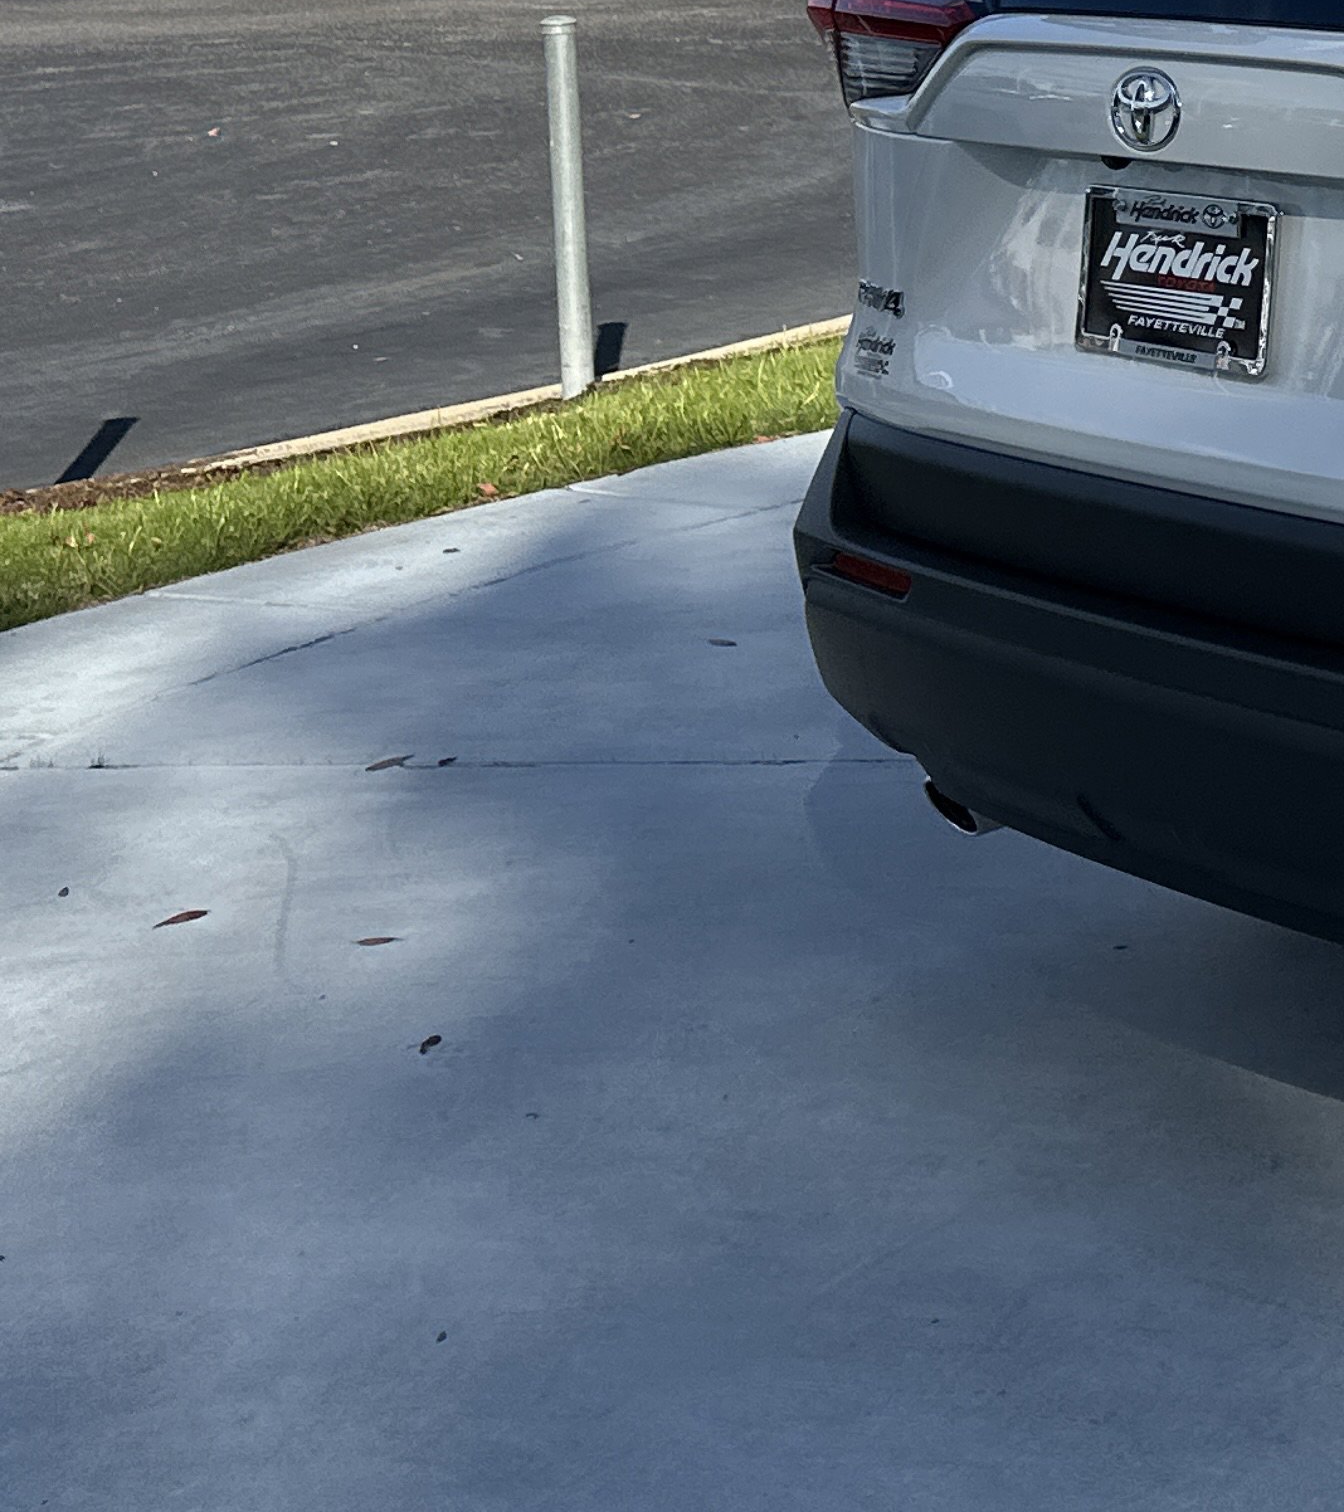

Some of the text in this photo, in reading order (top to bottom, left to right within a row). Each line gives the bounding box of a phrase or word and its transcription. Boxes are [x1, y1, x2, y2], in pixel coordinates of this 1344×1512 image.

[1129, 199, 1200, 224] Hendrick
[1101, 231, 1259, 286] Hendrick
[1127, 315, 1226, 338] FAYETTEVILLE
[1135, 345, 1197, 363] FAYETTEVILLE
